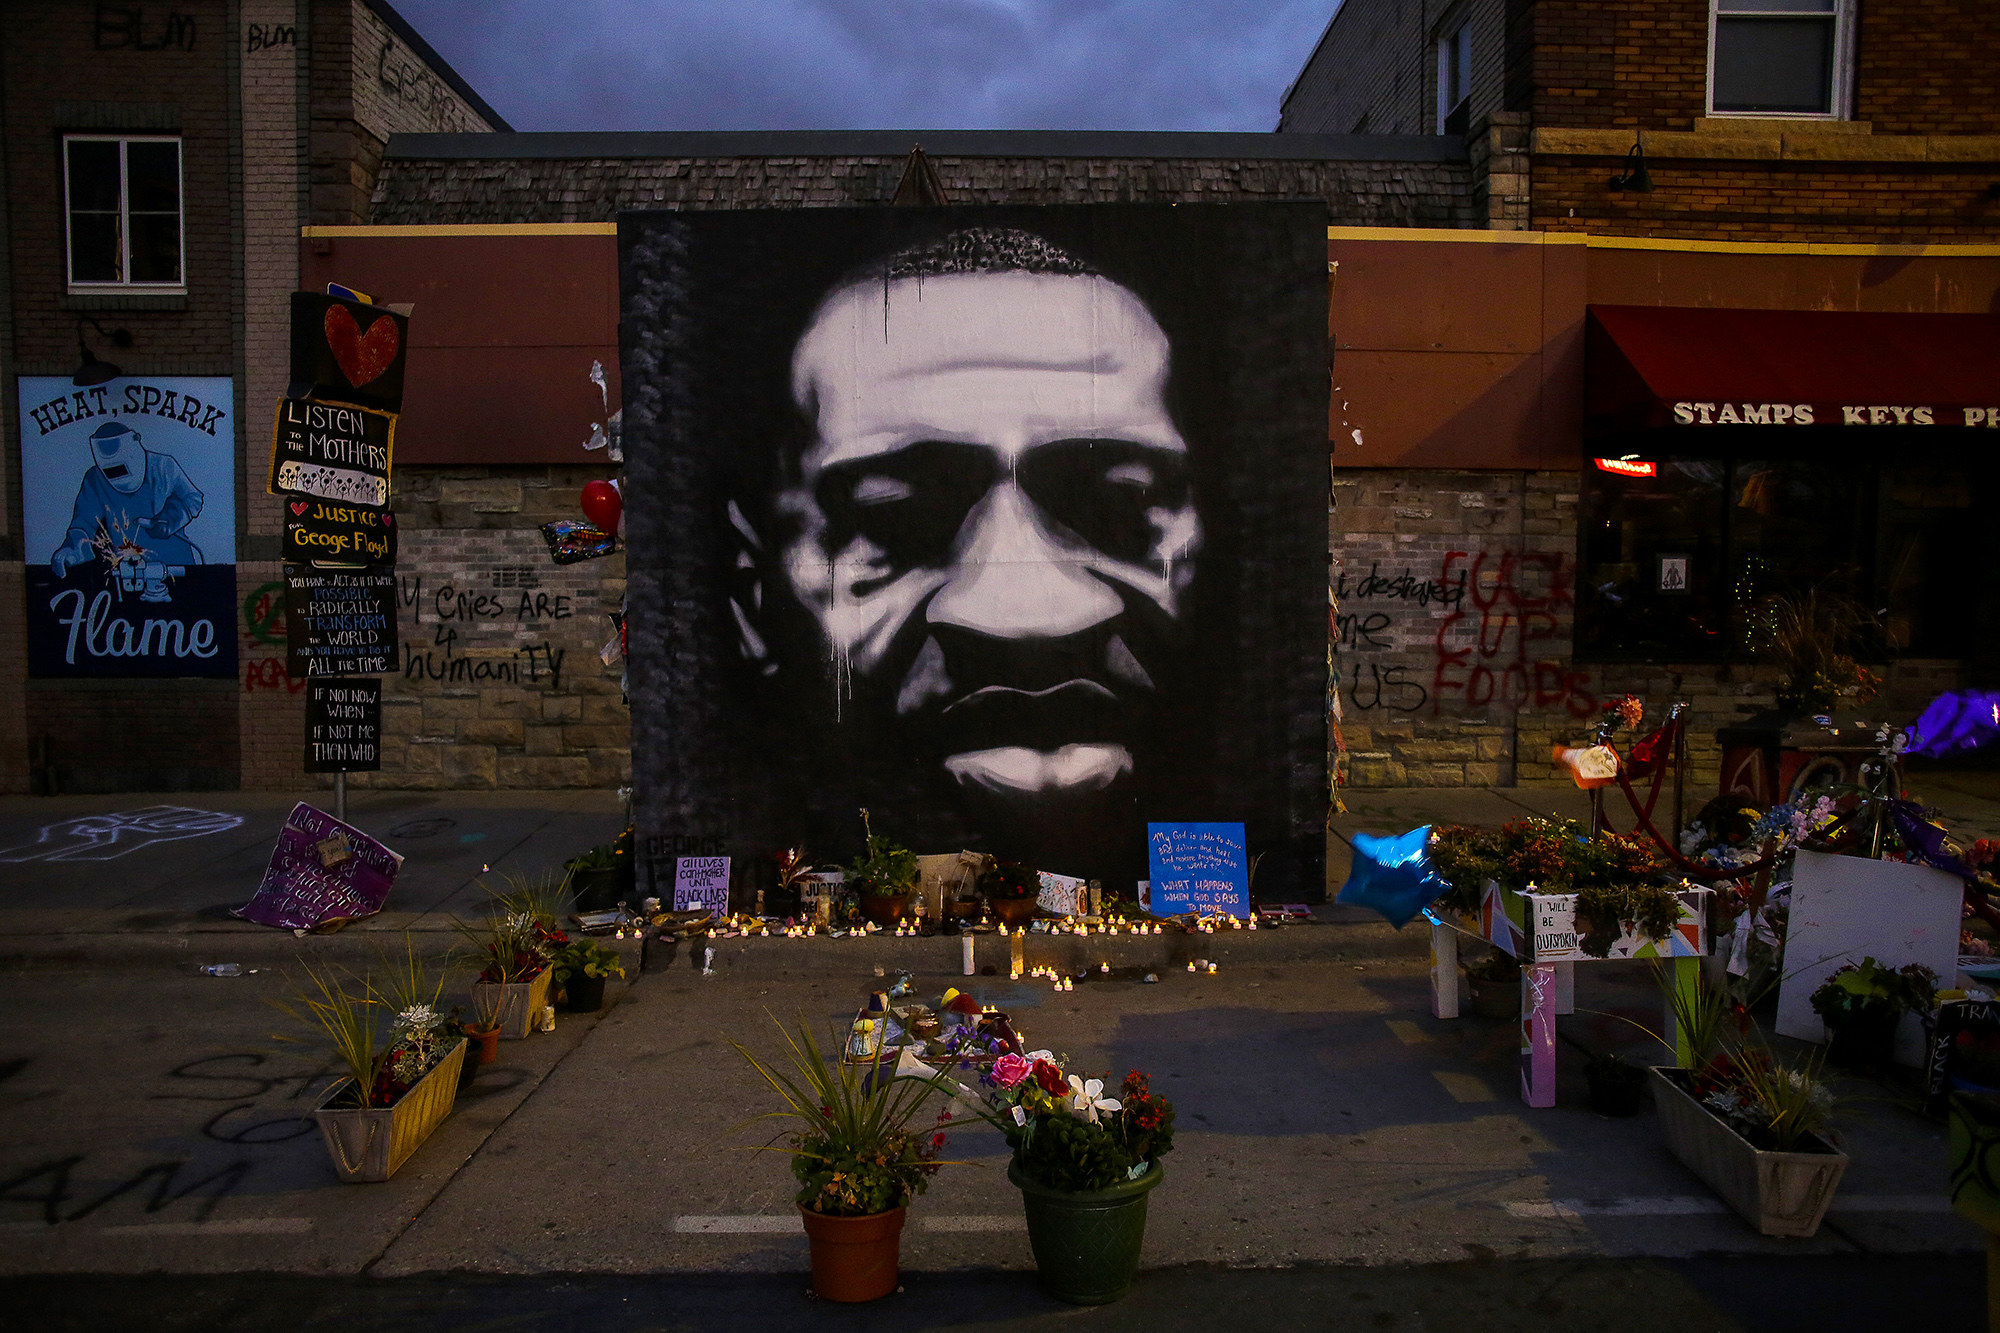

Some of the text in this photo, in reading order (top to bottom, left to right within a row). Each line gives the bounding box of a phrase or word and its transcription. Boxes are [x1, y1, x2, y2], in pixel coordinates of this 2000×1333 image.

[94, 2, 195, 52] BLM
[247, 24, 297, 52] BLM
[29, 385, 226, 437] HEAT, SPARK
[1673, 402, 1814, 426] STAMPS
[1842, 405, 1936, 426] KEYS
[294, 528, 389, 559] Geoge Floyd
[333, 574, 350, 587] ACT
[519, 591, 572, 620] ARE
[50, 589, 219, 665] Flame
[327, 630, 379, 645] WORLD
[434, 624, 458, 657] 4
[1438, 611, 1557, 665] CUP
[308, 657, 335, 675] ALL
[315, 687, 376, 705] IF NOT NOW
[1351, 664, 1427, 712] US
[1434, 657, 1598, 718] FOODS
[313, 725, 324, 739] IF
[328, 725, 354, 740] NOT
[349, 742, 374, 762] WHO
[1152, 831, 1172, 849] My
[1173, 830, 1187, 841] God
[1189, 832, 1197, 840] is
[1216, 835, 1224, 844] to
[689, 879, 714, 888] UNTIL
[1161, 879, 1234, 892] WHAT HAPPENS
[676, 889, 702, 905] BLACK
[1164, 892, 1240, 904] WHEN GOD SAYS
[1186, 903, 1222, 912] TO MOVE
[1539, 902, 1567, 913] I WILL
[1543, 916, 1554, 927] BE
[1536, 934, 1579, 951] OUTSPOKEN
